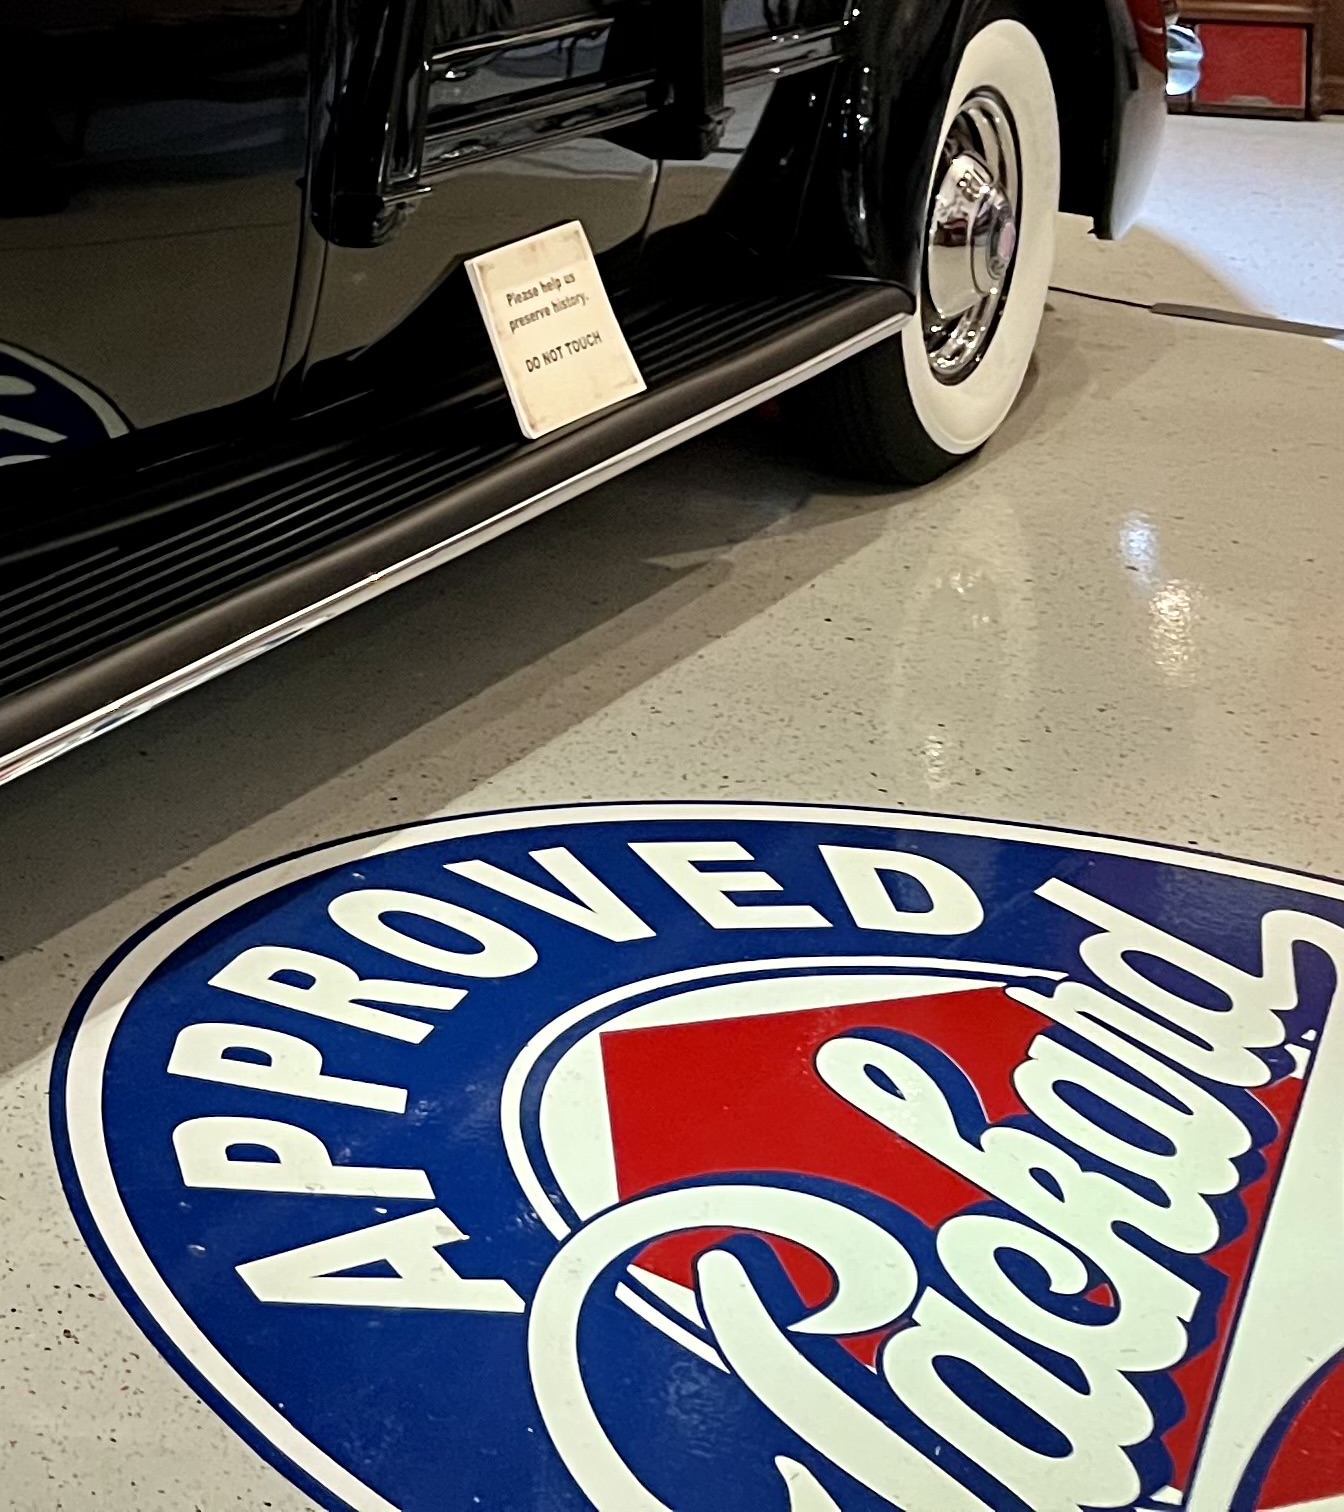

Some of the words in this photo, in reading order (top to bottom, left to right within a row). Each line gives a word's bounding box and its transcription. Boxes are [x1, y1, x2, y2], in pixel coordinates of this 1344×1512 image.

[506, 286, 539, 307] Please
[539, 276, 562, 292] help
[563, 273, 576, 284] us
[509, 306, 551, 335] preserve
[551, 292, 590, 314] history.
[525, 356, 541, 373] DO
[541, 345, 564, 366] NOT
[564, 330, 603, 355] TOUCH
[168, 841, 984, 1313] APPROVED
